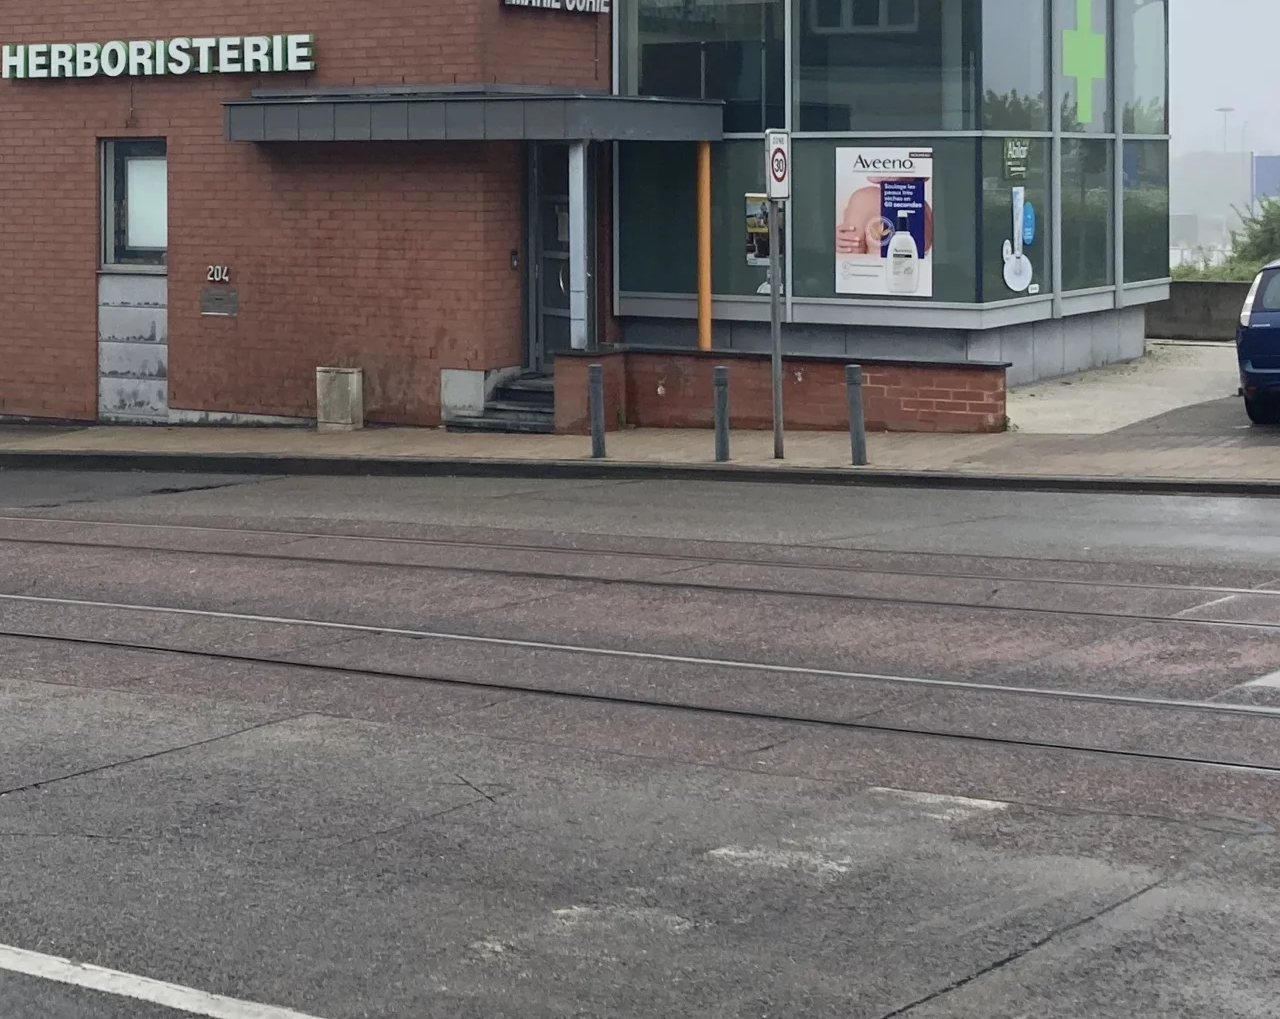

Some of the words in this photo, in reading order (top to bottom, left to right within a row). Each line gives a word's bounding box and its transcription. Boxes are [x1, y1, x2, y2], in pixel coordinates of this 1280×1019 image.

[1, 34, 315, 79] HERBORISTERIE
[772, 136, 784, 145] ZONE
[774, 158, 784, 173] 30
[853, 154, 914, 169] Aveeno
[207, 265, 229, 281] 204
